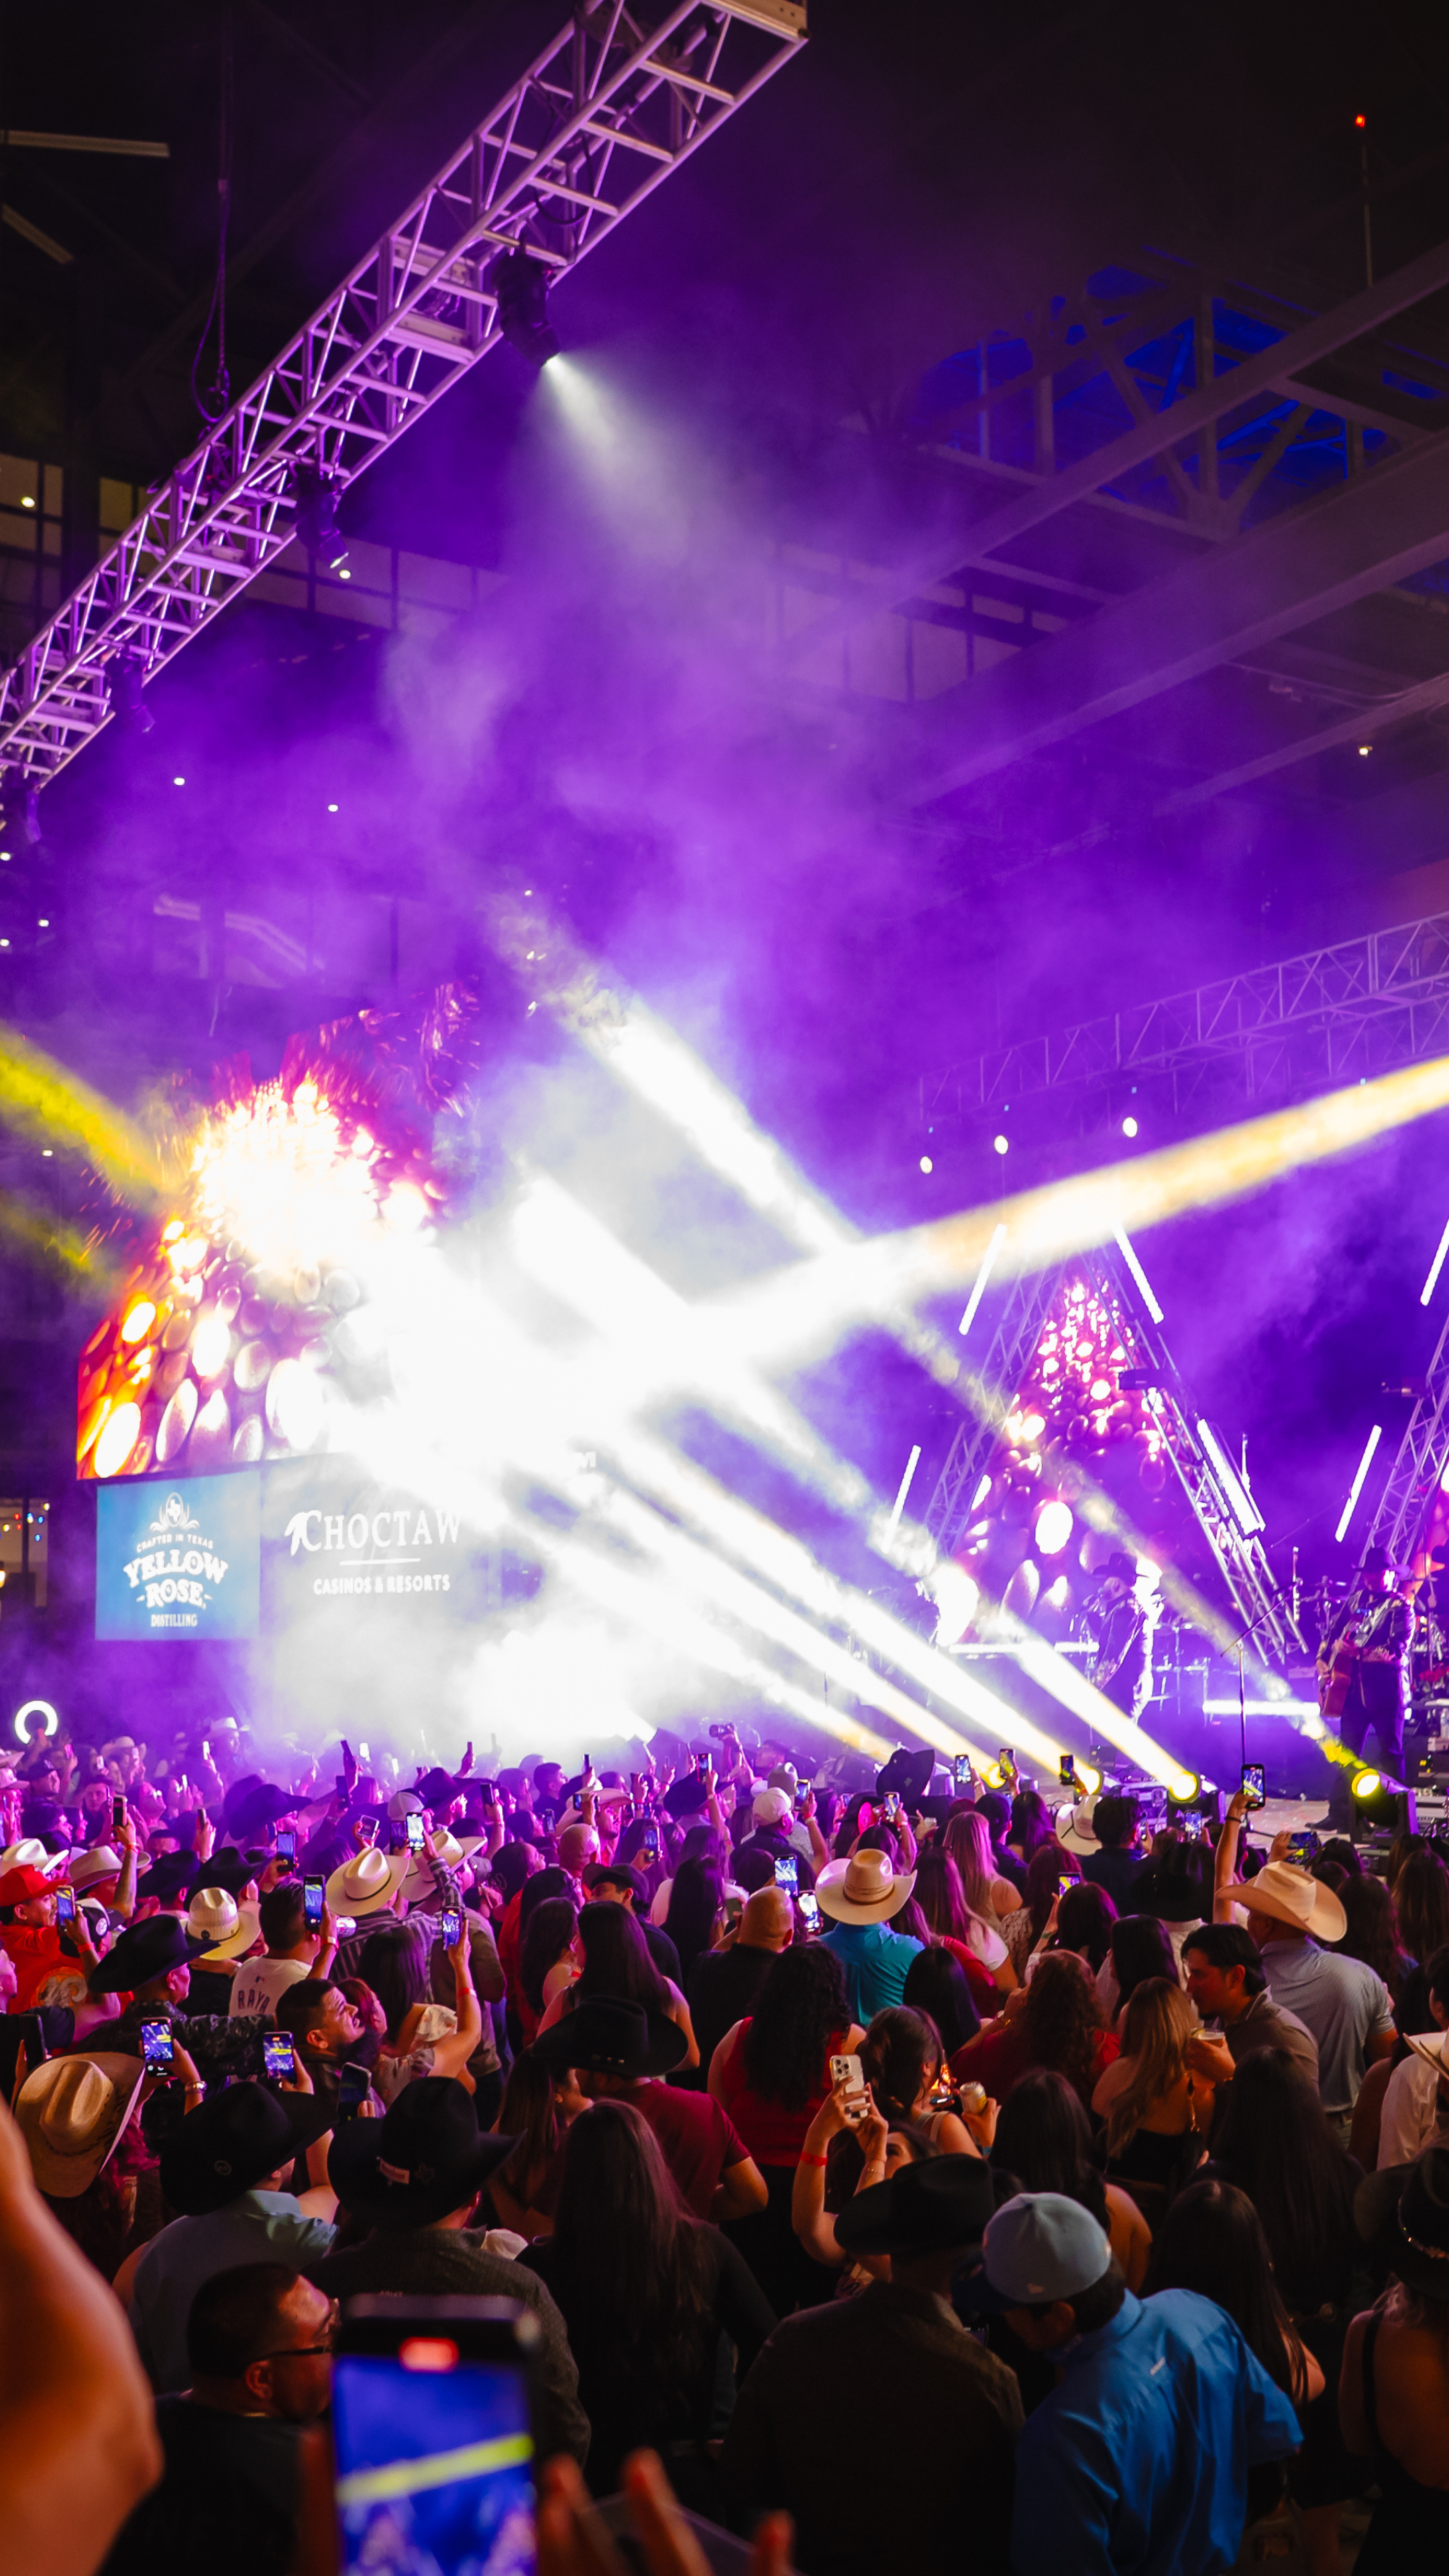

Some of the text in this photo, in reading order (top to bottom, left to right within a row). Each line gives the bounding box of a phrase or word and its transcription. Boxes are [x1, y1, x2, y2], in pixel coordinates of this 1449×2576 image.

[295, 1509, 460, 1554] CHOCTAW
[137, 1534, 214, 1553] CRAFTED IN TEXAS
[123, 1549, 229, 1589] YELLOW
[313, 1574, 450, 1595] CASINOS & RESORTS
[151, 1613, 198, 1628] DISTILLING
